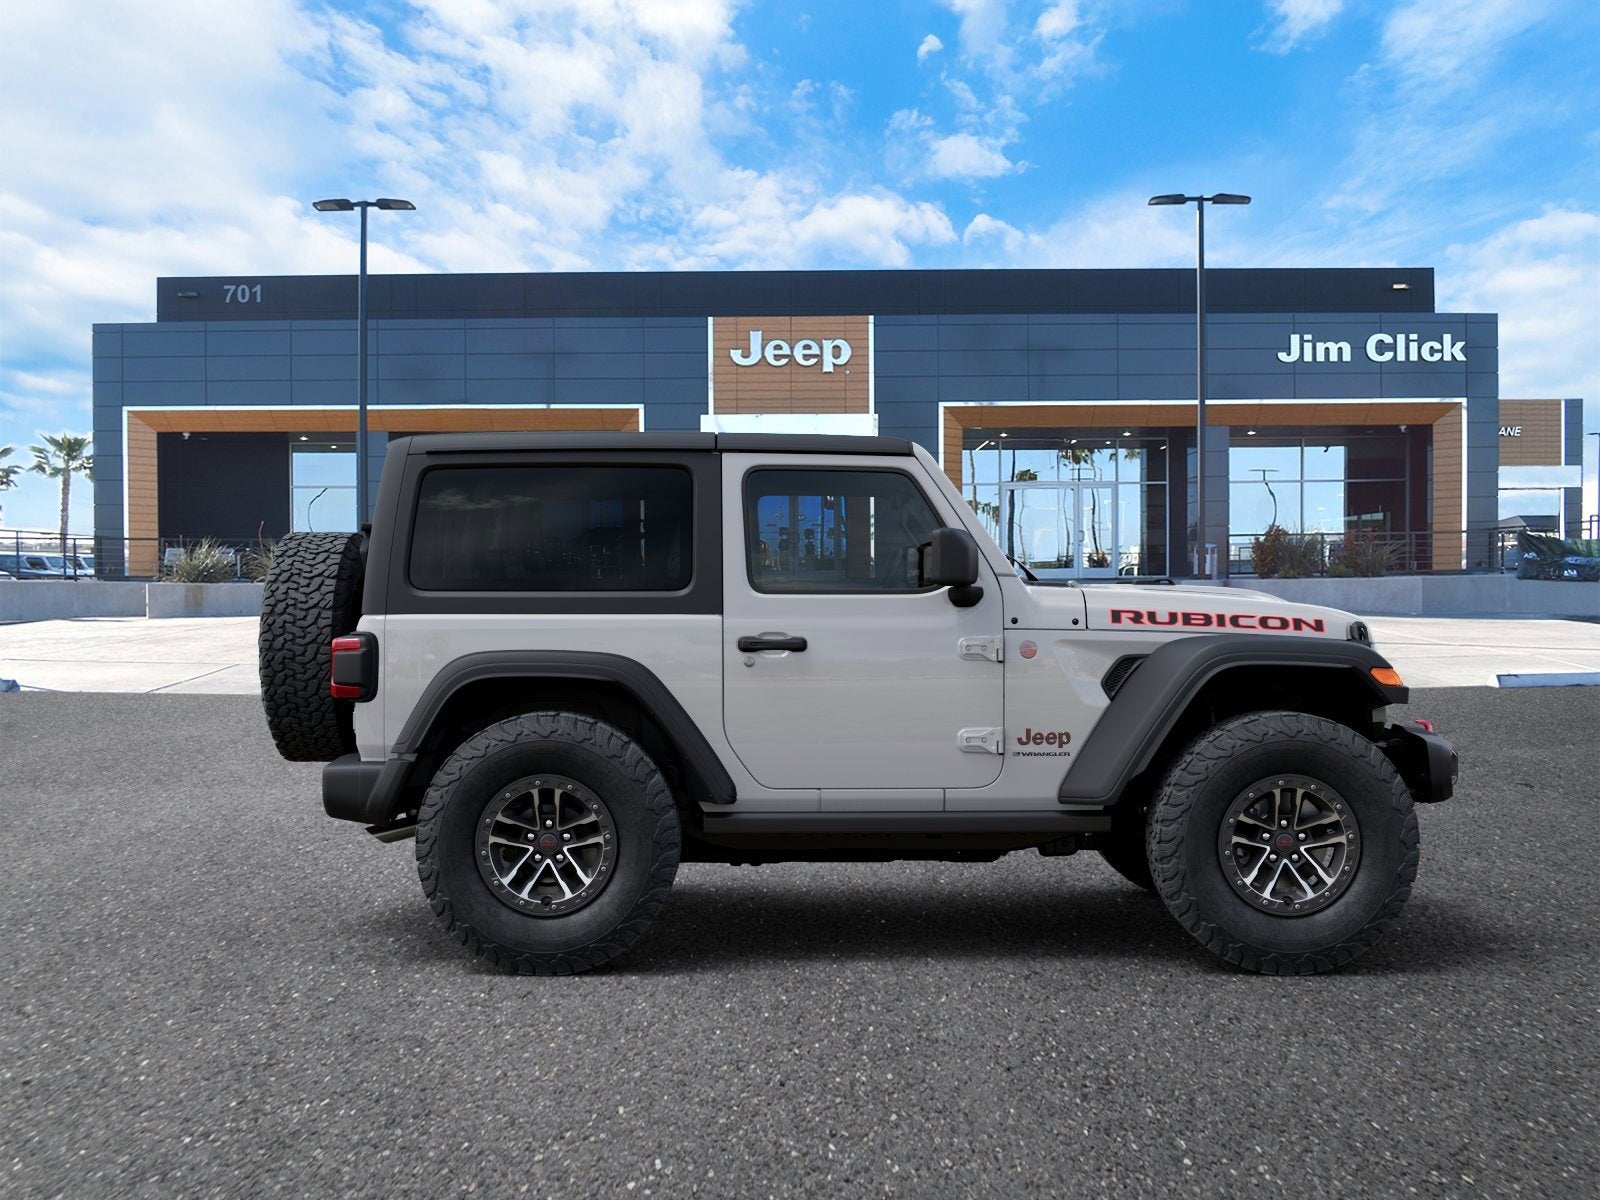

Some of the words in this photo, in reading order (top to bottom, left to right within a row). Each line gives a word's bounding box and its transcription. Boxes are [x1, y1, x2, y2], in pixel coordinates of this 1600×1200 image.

[223, 284, 262, 303] 701
[729, 330, 852, 373] Jeep
[1277, 333, 1352, 363] Jim
[1365, 333, 1467, 363] Click
[1110, 609, 1325, 633] RUBICON
[1017, 728, 1071, 748] Jeep
